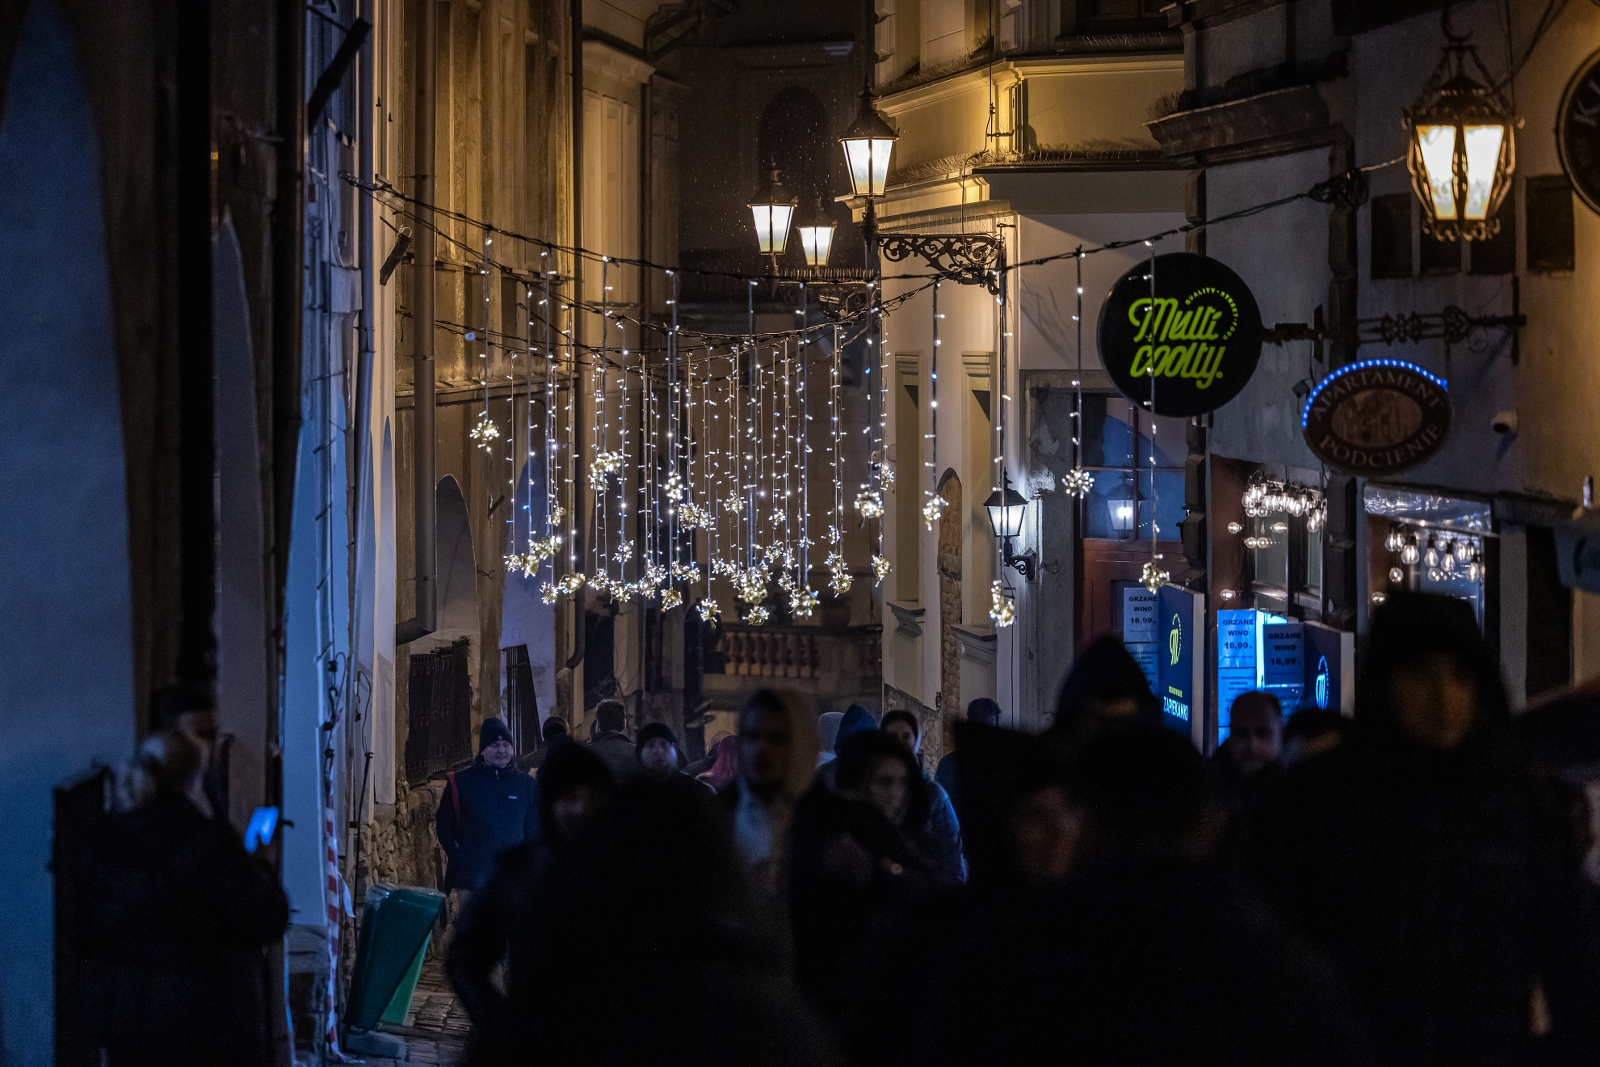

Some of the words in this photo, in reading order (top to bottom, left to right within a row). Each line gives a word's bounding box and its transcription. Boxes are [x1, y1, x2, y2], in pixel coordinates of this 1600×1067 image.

[1127, 297, 1223, 343] Multi
[1313, 371, 1441, 421] APARTAMENT
[1319, 425, 1442, 467] PODCIENIE
